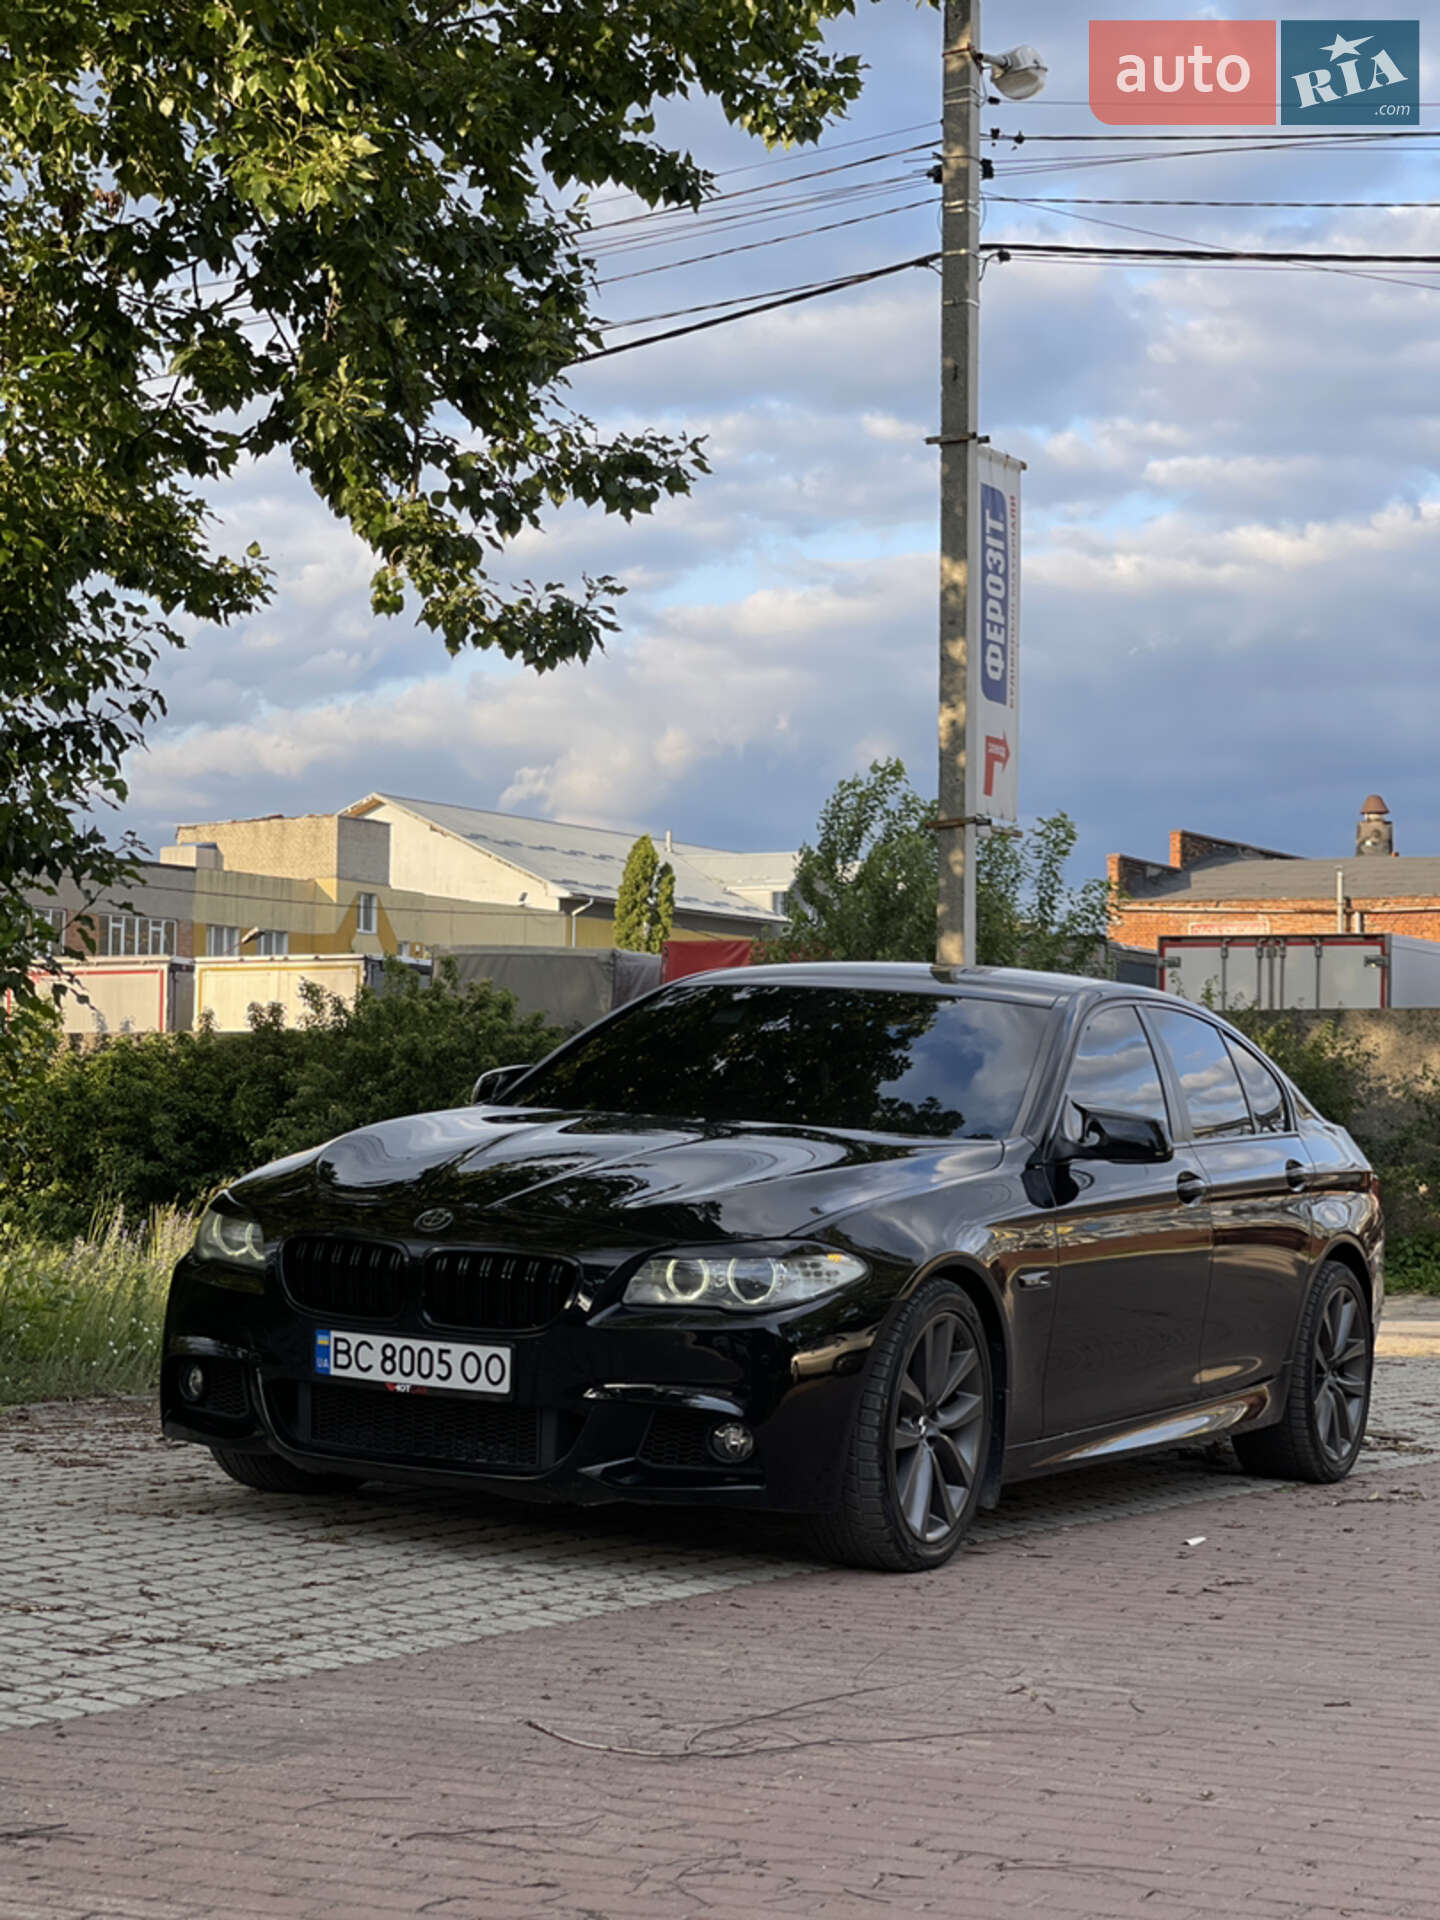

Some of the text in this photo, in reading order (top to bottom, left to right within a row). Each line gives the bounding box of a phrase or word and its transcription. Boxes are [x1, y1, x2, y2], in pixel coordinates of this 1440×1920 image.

[985, 509, 1006, 682] ФЕРОЗІТ
[333, 1337, 506, 1386] BC 8005 OO
